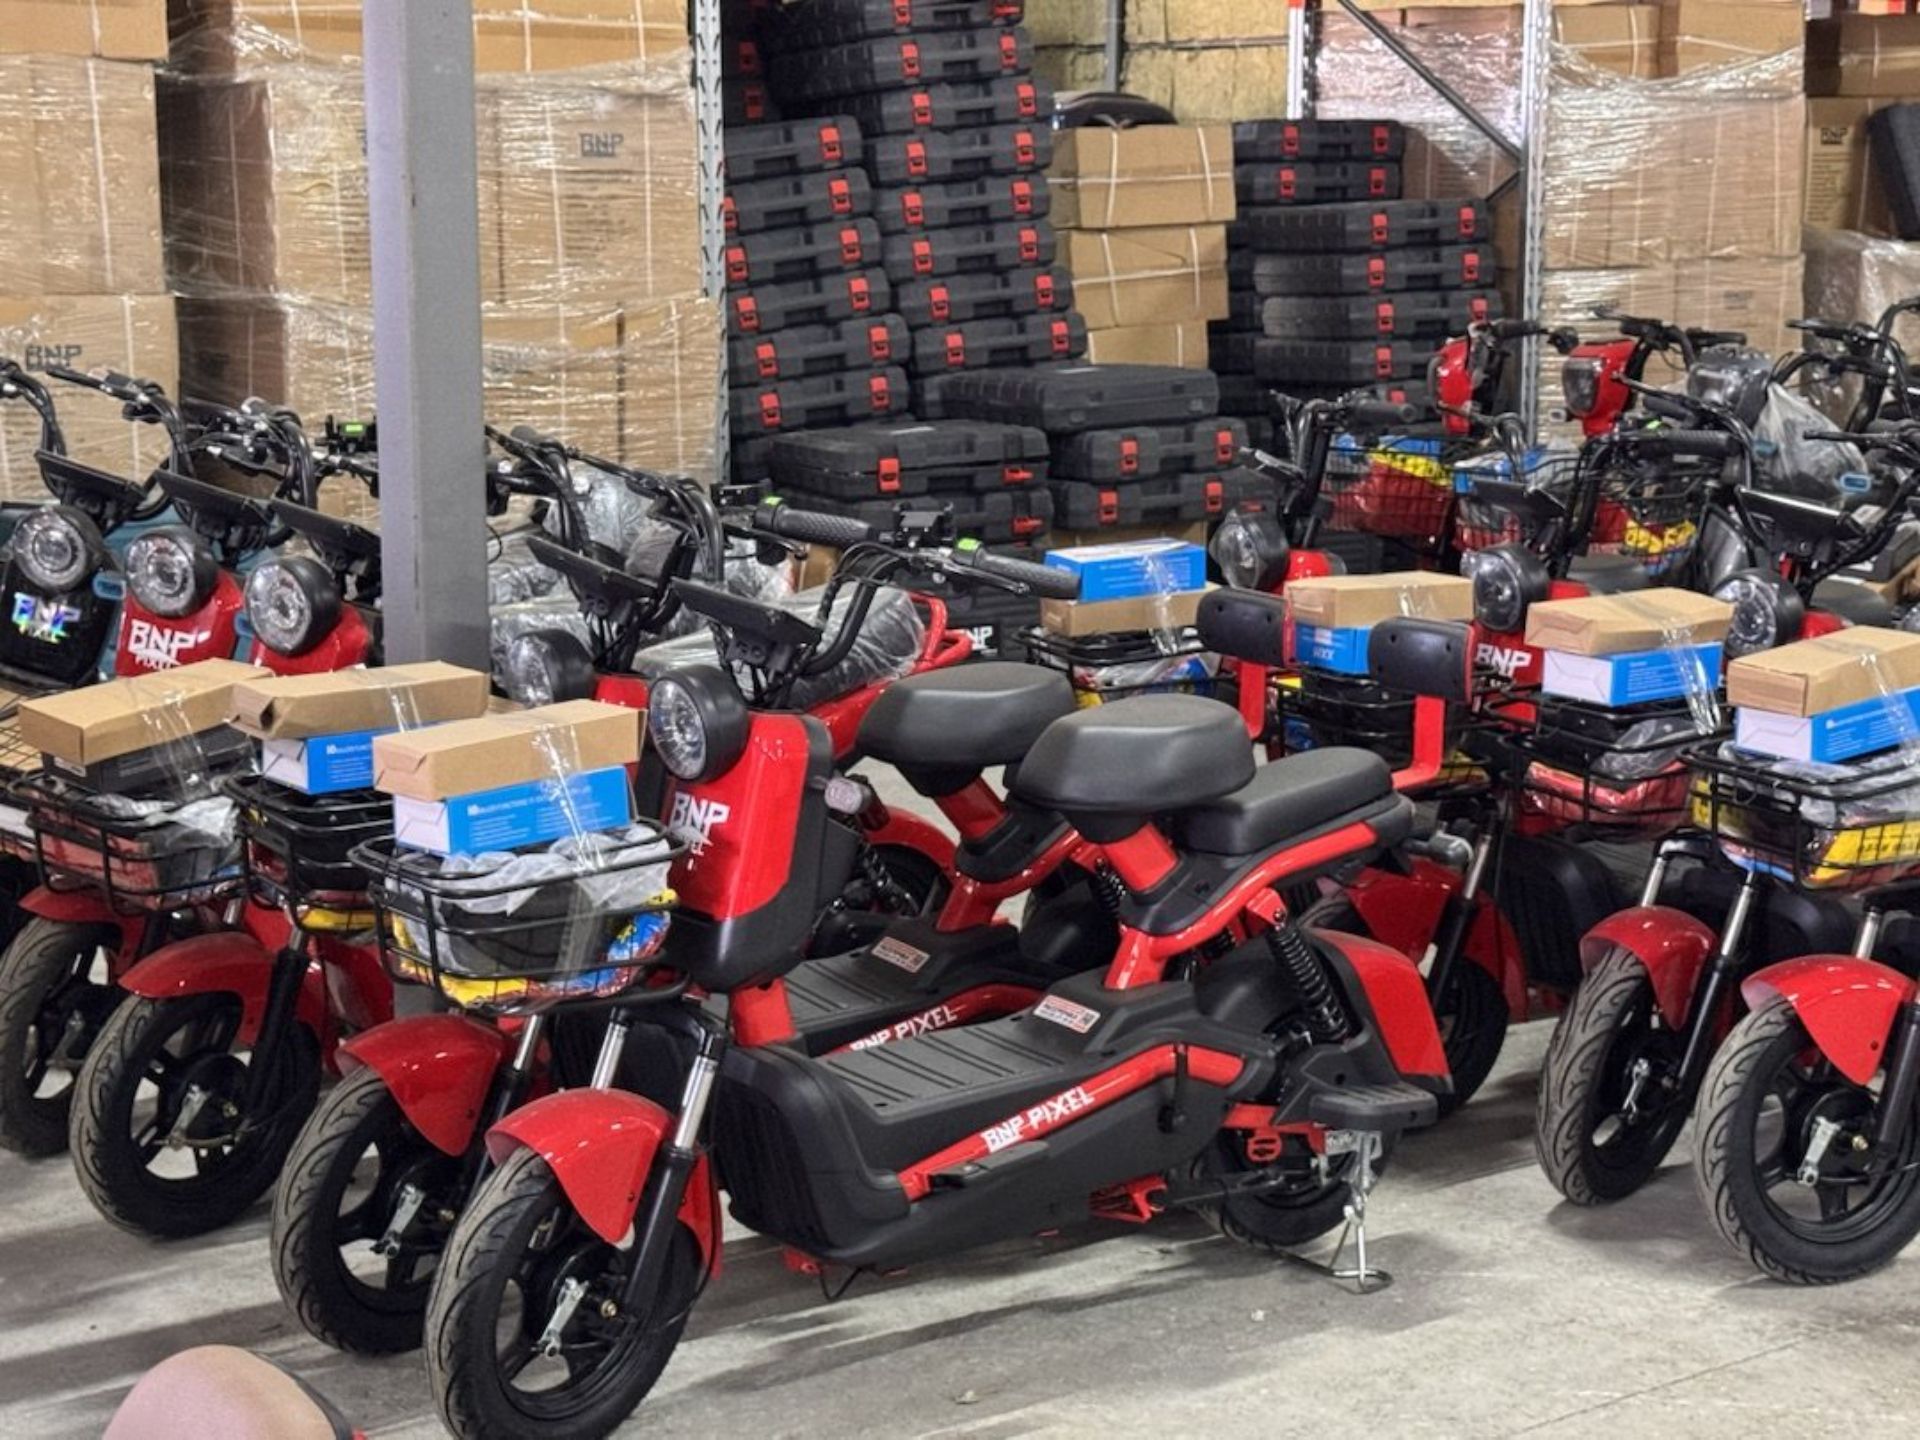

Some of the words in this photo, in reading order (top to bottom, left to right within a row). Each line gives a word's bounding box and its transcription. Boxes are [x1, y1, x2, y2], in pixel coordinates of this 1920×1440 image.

[579, 132, 624, 157] BNP
[26, 344, 82, 371] BNP
[12, 592, 81, 633] BNP
[128, 619, 196, 662] BNP
[1475, 643, 1533, 678] BNP
[668, 791, 731, 838] BNP
[894, 1005, 958, 1040] PIXEL
[980, 1114, 1026, 1153] BNP
[1027, 1085, 1095, 1130] PIXEL
